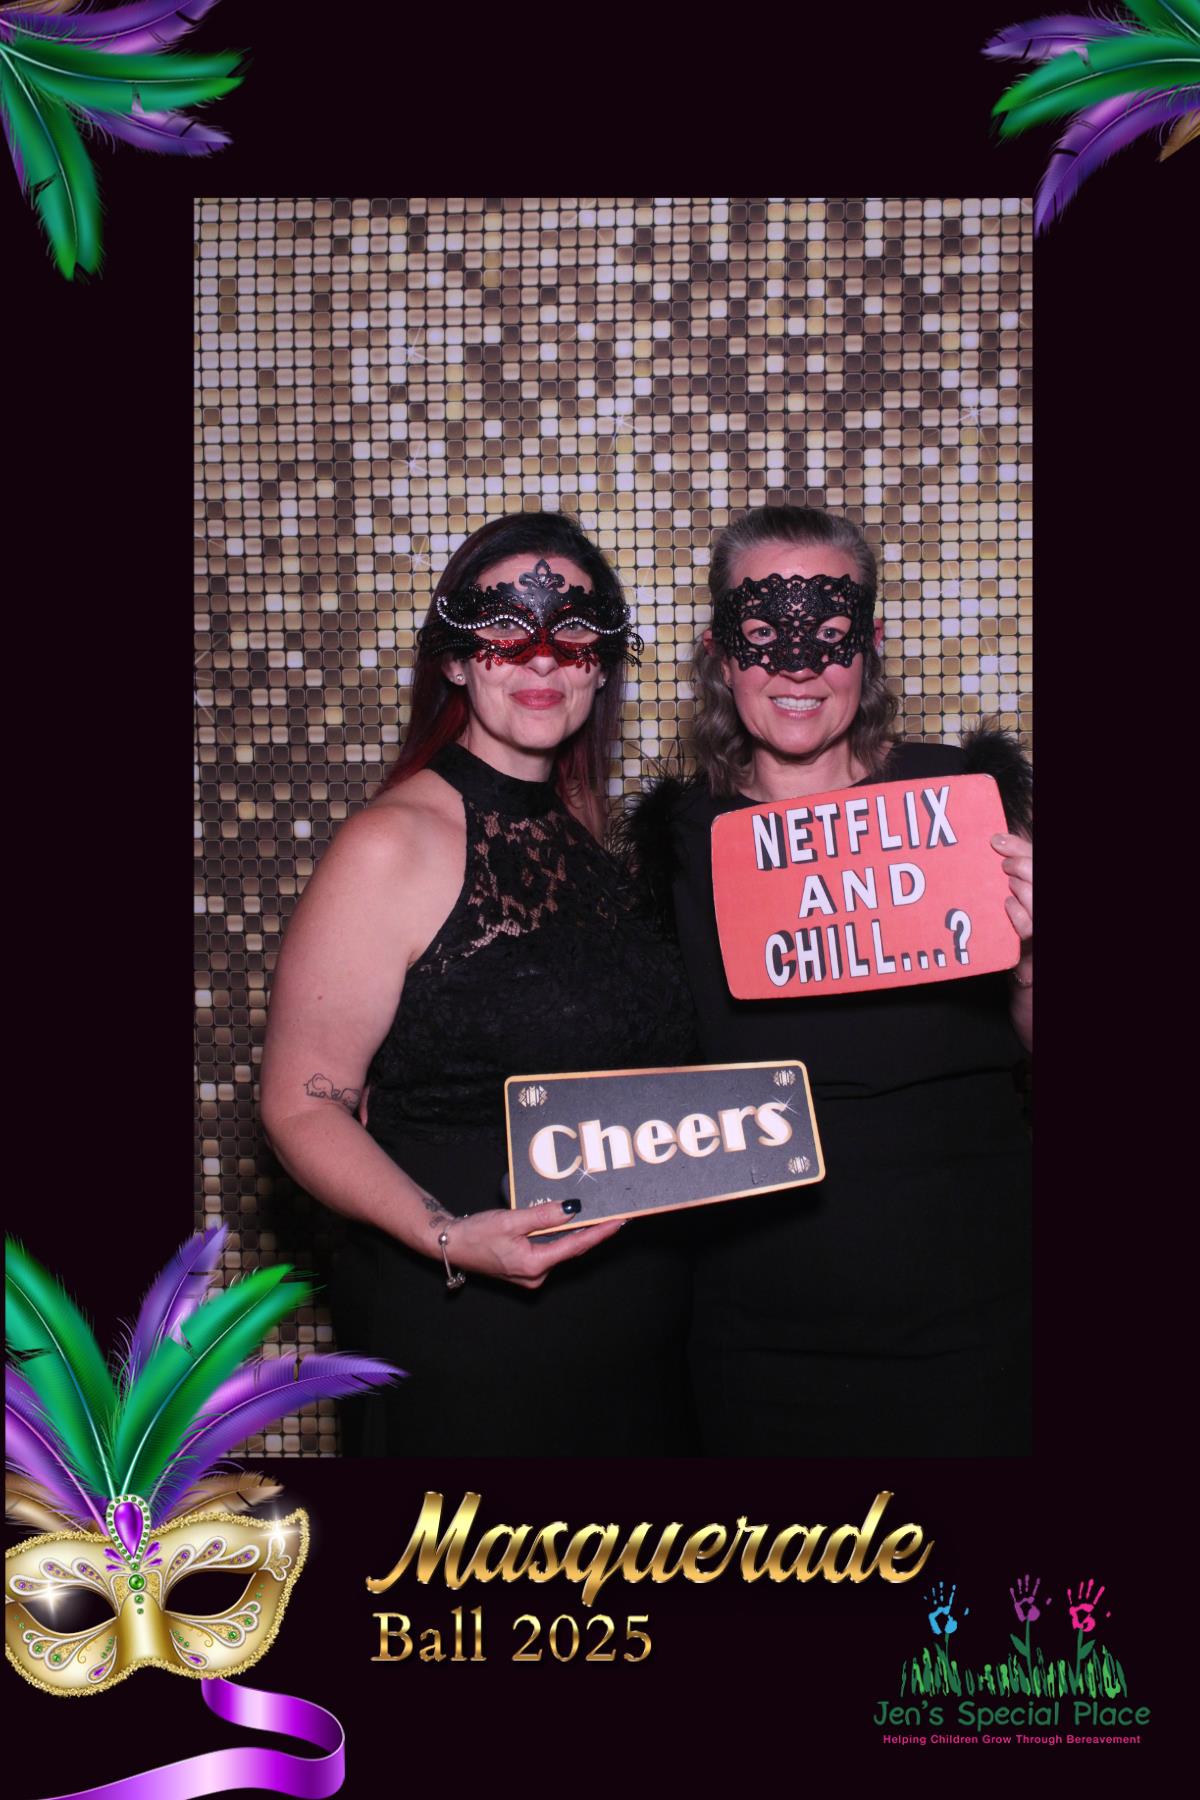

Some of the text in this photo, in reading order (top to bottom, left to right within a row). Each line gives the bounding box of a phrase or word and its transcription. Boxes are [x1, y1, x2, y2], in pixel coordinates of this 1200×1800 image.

[752, 786, 958, 870] NETFLIX
[798, 862, 926, 918] AND
[528, 1102, 793, 1180] Cheers
